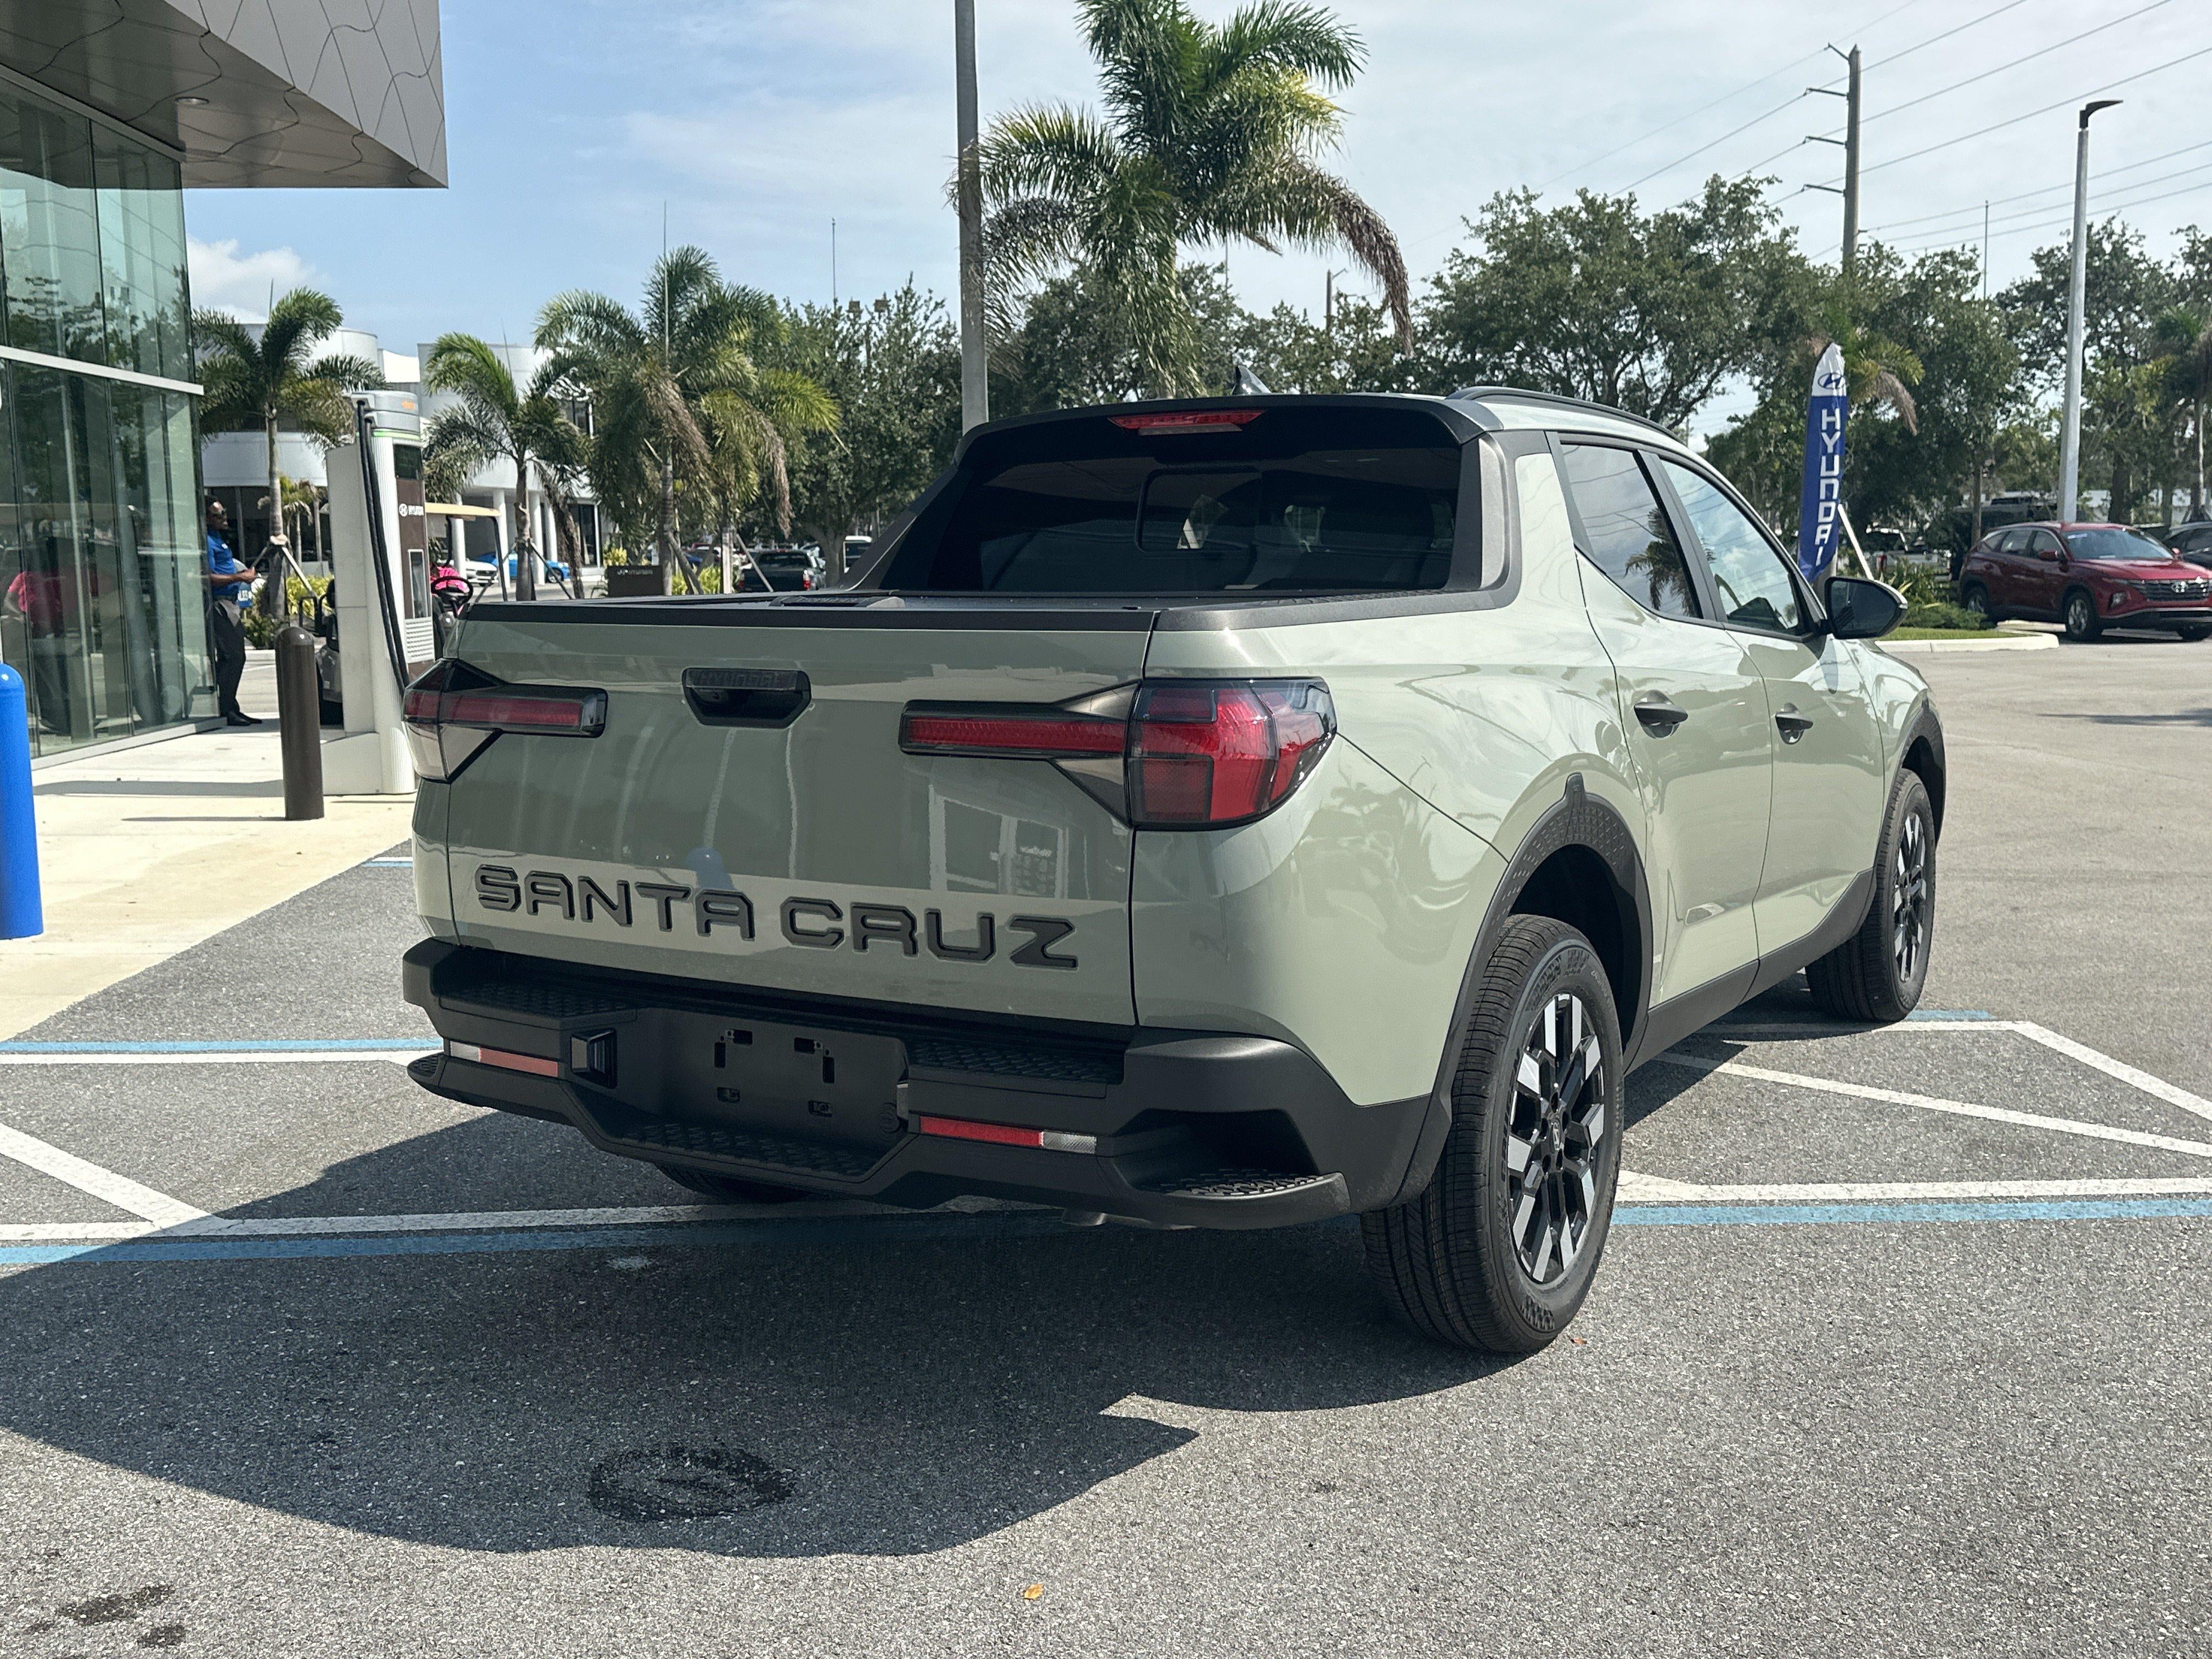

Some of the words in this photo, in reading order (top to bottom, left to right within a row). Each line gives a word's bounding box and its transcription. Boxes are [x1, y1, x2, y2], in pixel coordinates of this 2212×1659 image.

[1815, 408, 1841, 566] HYUNDAI
[475, 864, 756, 942] SANTA
[781, 896, 1079, 970] CRUZ
